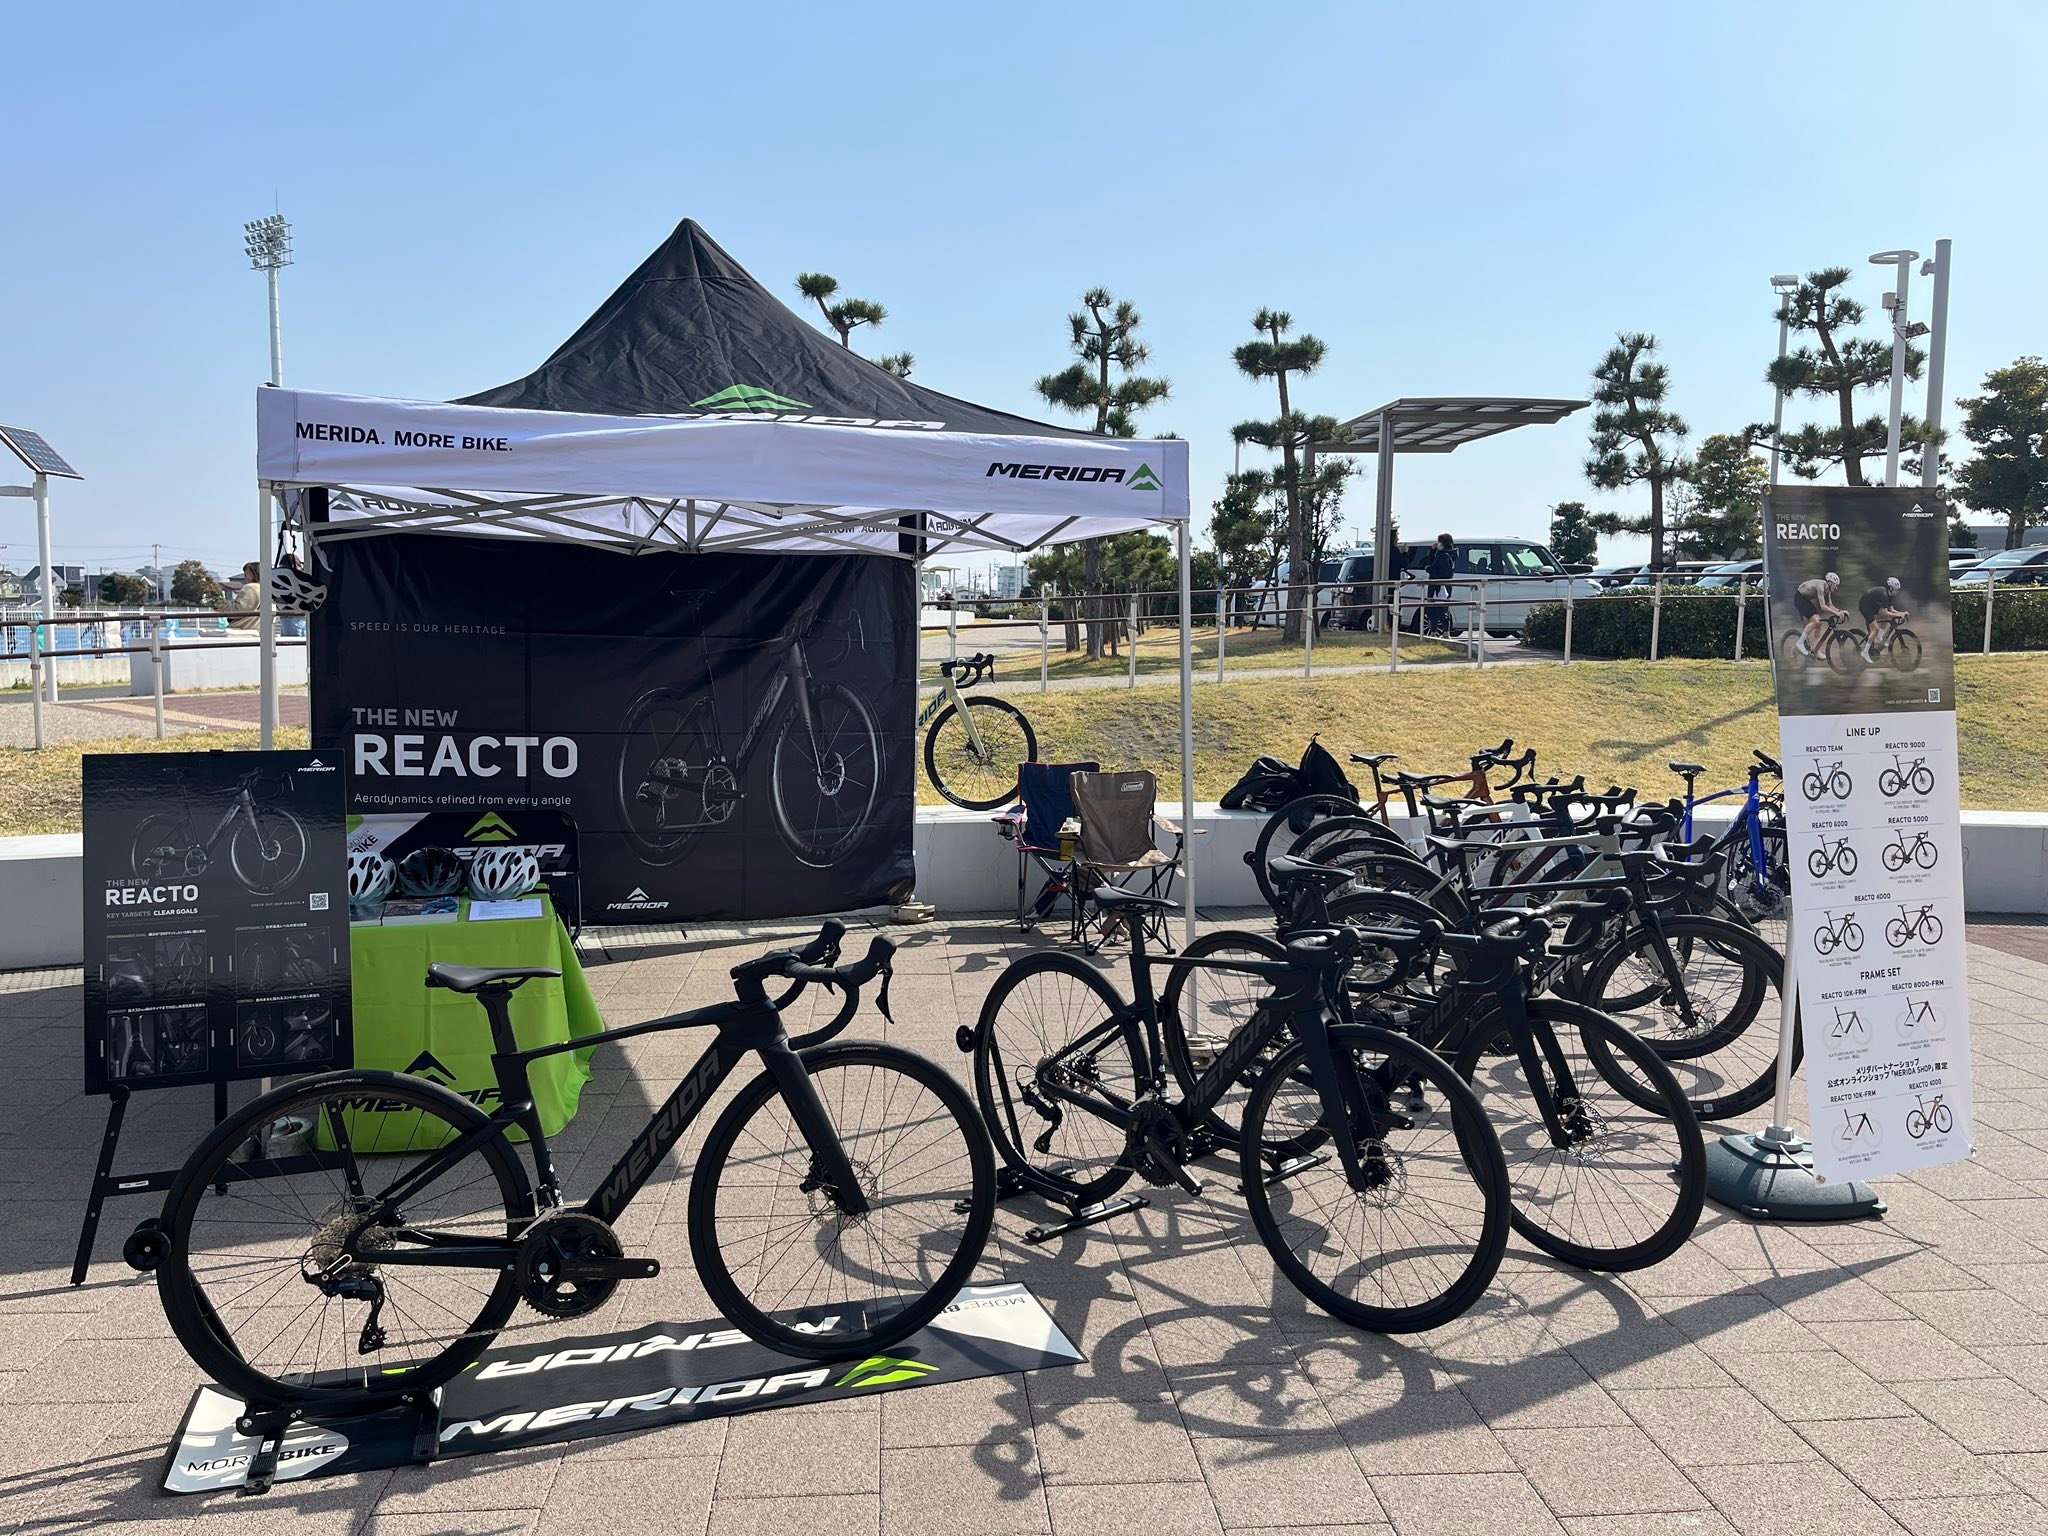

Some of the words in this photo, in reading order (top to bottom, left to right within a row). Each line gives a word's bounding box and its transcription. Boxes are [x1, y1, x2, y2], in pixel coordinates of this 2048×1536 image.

[295, 421, 385, 446] MERIDA.
[394, 430, 455, 450] MORE
[462, 436, 514, 453] BIKE.
[986, 462, 1126, 483] MERIDA
[1776, 513, 1792, 521] THE
[1793, 513, 1807, 521] NEW
[1776, 523, 1840, 540] REACTO
[350, 621, 391, 632] SPEED
[396, 623, 408, 632] IS
[413, 623, 439, 633] OUR
[444, 624, 506, 635] HERITAGE
[352, 707, 397, 726] THE
[404, 709, 458, 727] NEW
[1846, 728, 1866, 737] LINE
[1868, 727, 1881, 736] UP
[354, 733, 578, 779] REACTO
[354, 793, 433, 806] Aerodynamics
[436, 793, 475, 805] refined
[478, 794, 504, 805] from
[507, 797, 539, 807] every
[541, 795, 571, 807] angle
[1811, 821, 1832, 829] REACTO
[1888, 816, 1911, 824] REACTO
[106, 879, 126, 887] THE
[128, 878, 150, 887] NEW
[105, 885, 199, 906] REACTO
[1854, 894, 1875, 902] REACTO
[606, 900, 669, 910] MERIDA
[121, 910, 151, 918] TARGETS
[153, 909, 175, 917] CLEAR
[176, 907, 198, 915] GOALS
[1860, 969, 1886, 980] FRAME
[1888, 967, 1901, 977] SET
[1891, 983, 1912, 991] REACTO
[1821, 991, 1842, 1000] REACTO
[1908, 1081, 1928, 1090] REACTO
[1929, 1078, 1942, 1087] 4000
[1830, 1094, 1852, 1103] REACTO
[602, 1049, 720, 1216] MERIDA
[439, 1368, 831, 1443] MERIDA
[278, 1444, 337, 1461] BIKE
